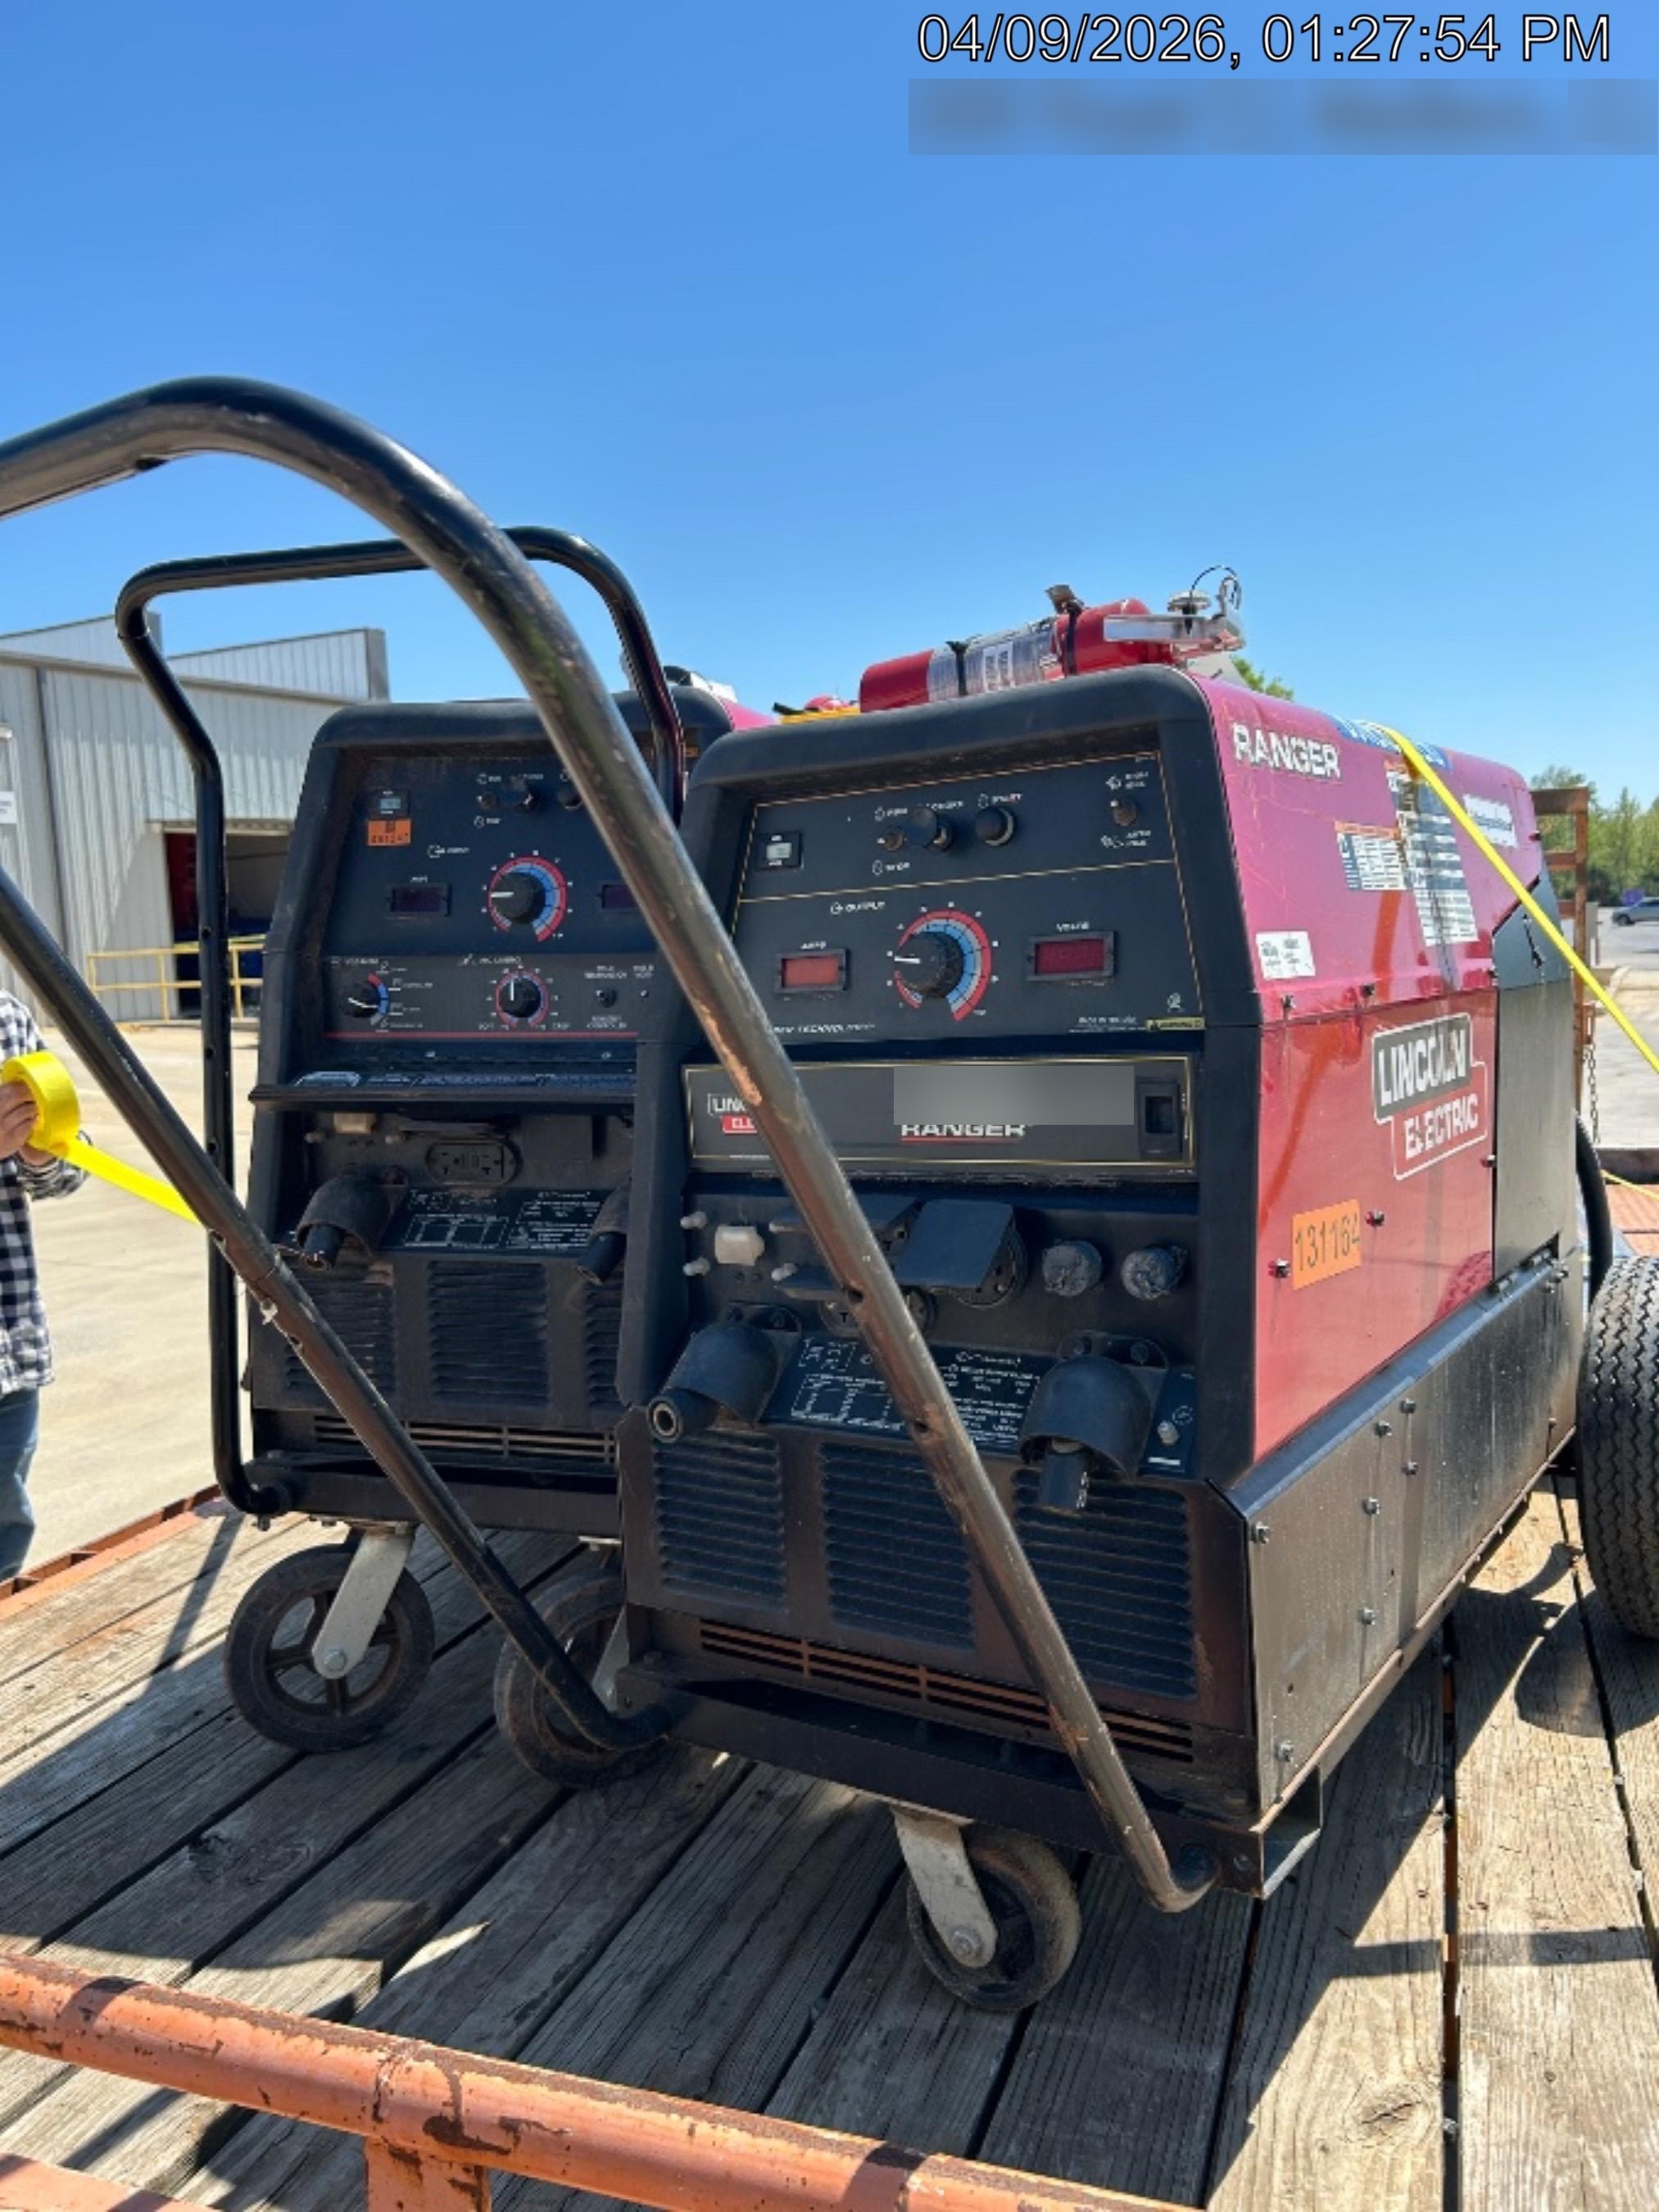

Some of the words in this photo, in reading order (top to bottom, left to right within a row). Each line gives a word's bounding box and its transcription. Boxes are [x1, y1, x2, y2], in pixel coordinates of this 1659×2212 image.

[1232, 722, 1341, 778] RANGER
[1378, 1029, 1466, 1107] LINCOLN
[1403, 1093, 1479, 1160] ELECTRIC
